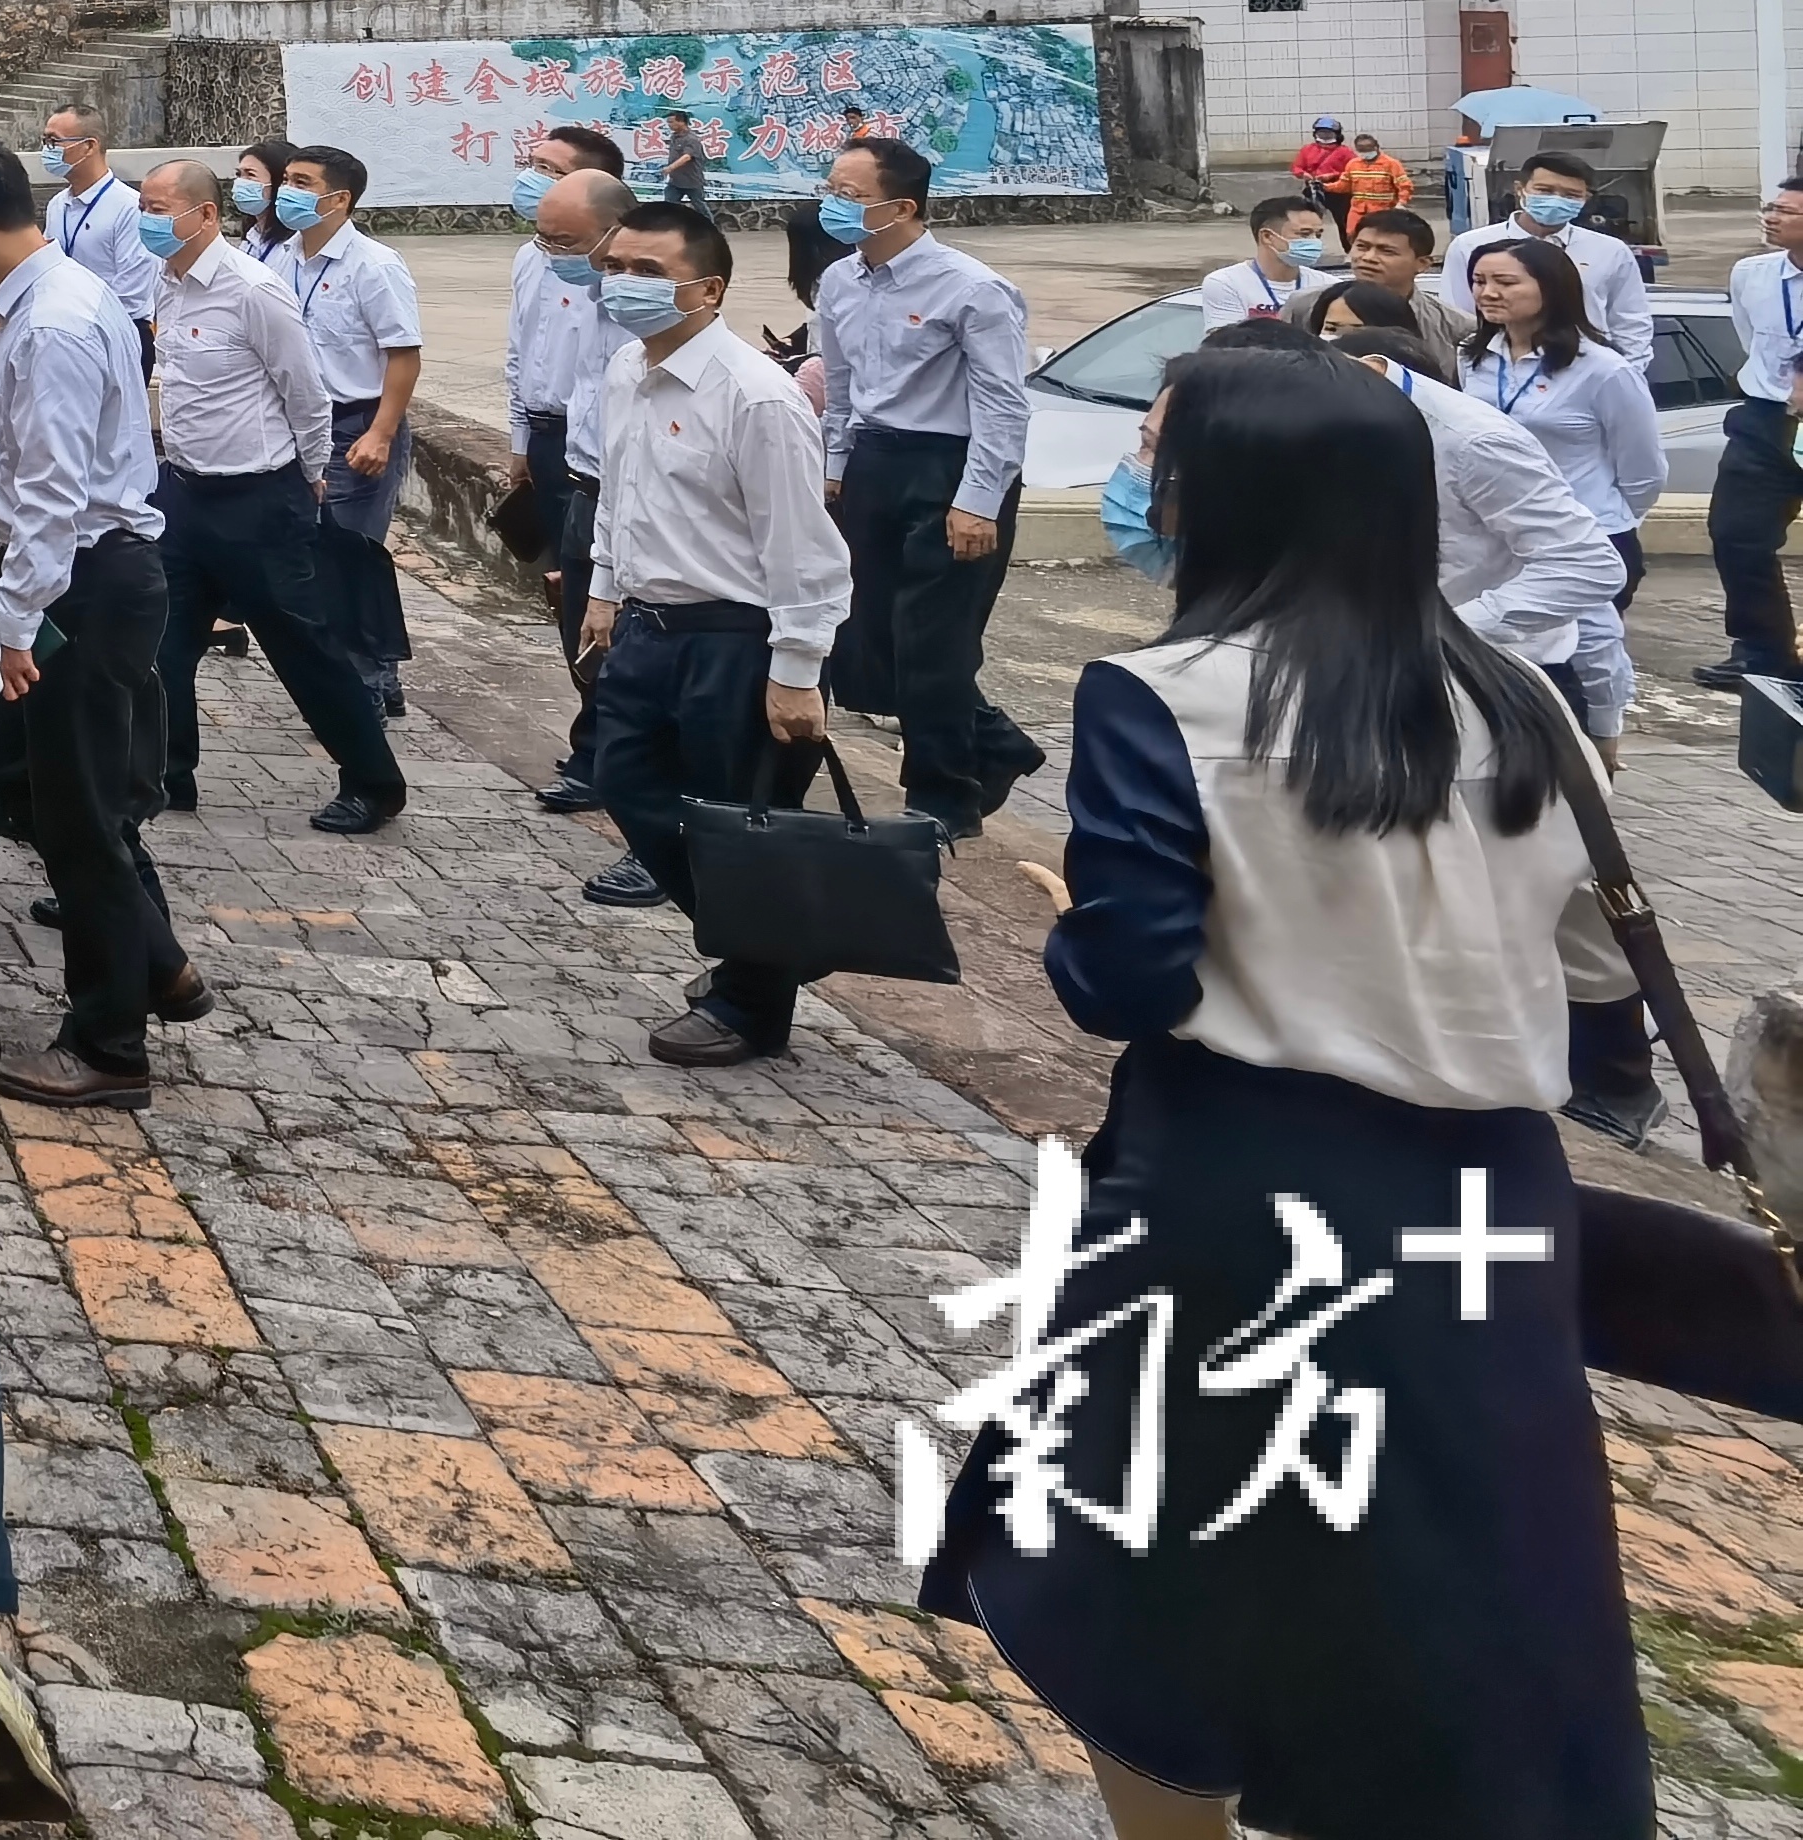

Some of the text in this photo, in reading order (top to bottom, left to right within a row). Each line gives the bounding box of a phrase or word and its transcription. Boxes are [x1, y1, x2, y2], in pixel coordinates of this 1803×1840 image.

[344, 52, 859, 104] 创建全域旅游示范区
[451, 112, 903, 165] 打造区活力城市
